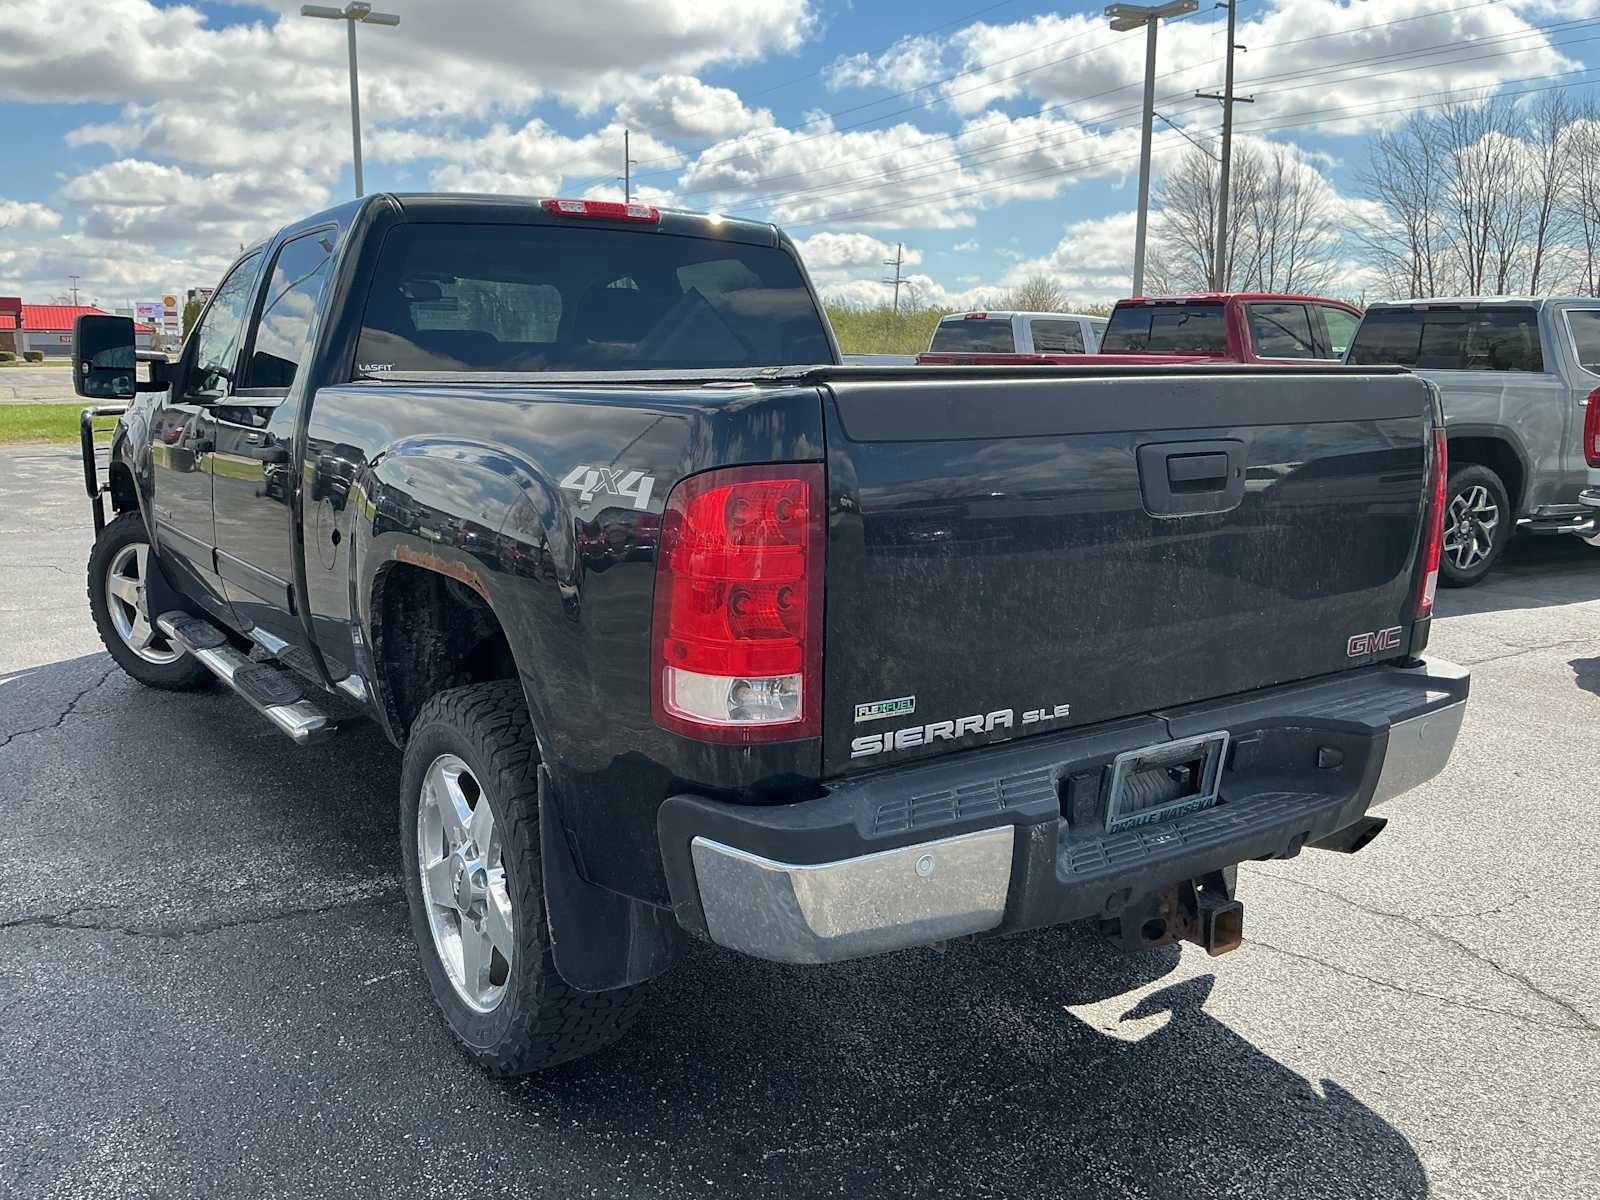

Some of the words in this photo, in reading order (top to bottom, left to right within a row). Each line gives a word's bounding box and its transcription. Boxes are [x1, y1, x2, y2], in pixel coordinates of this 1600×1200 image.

[359, 363, 393, 371] LASFIT
[1347, 626, 1402, 657] GMC
[851, 709, 1013, 759] SIERRA
[1022, 704, 1070, 724] SLE
